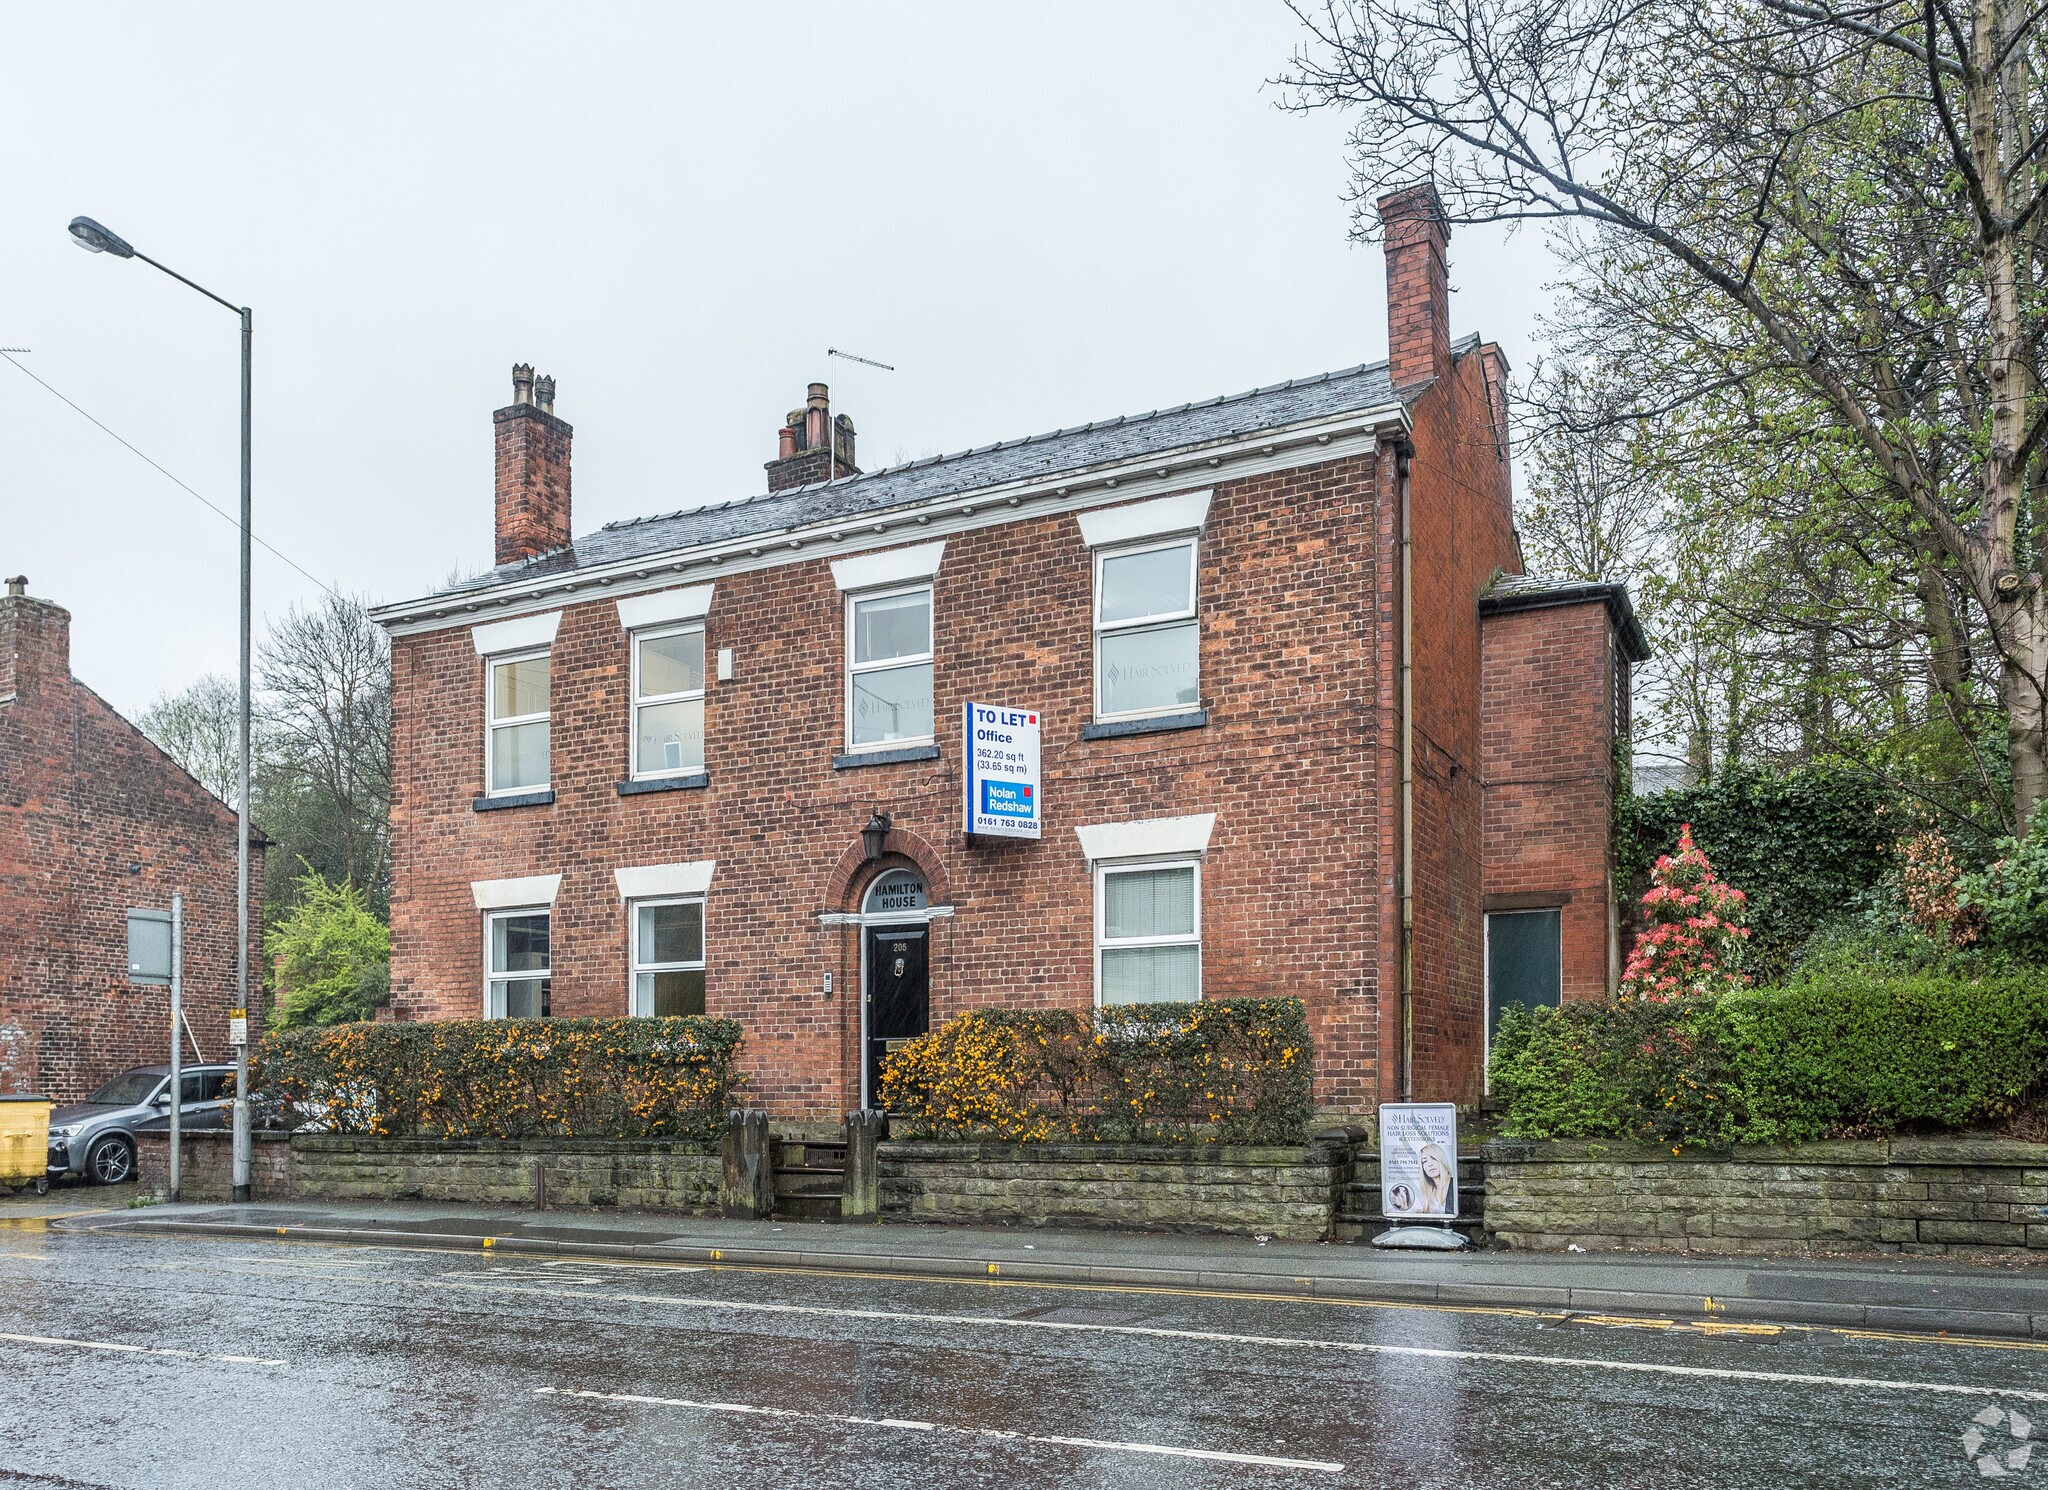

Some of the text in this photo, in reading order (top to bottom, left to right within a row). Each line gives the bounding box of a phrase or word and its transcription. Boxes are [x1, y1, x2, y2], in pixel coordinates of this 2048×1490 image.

[977, 709, 1027, 728] TO LET
[977, 729, 1013, 744] Office
[977, 748, 1025, 763] 362.20 sq ft
[977, 760, 1027, 776] (33.65 sq m)
[989, 786, 1016, 800] Nolan
[989, 800, 1032, 815] Redshaw
[977, 816, 1038, 831] 0161 763 0828
[875, 882, 923, 897] HAMILTON
[882, 896, 916, 908] HOUSE
[893, 943, 907, 952] 205
